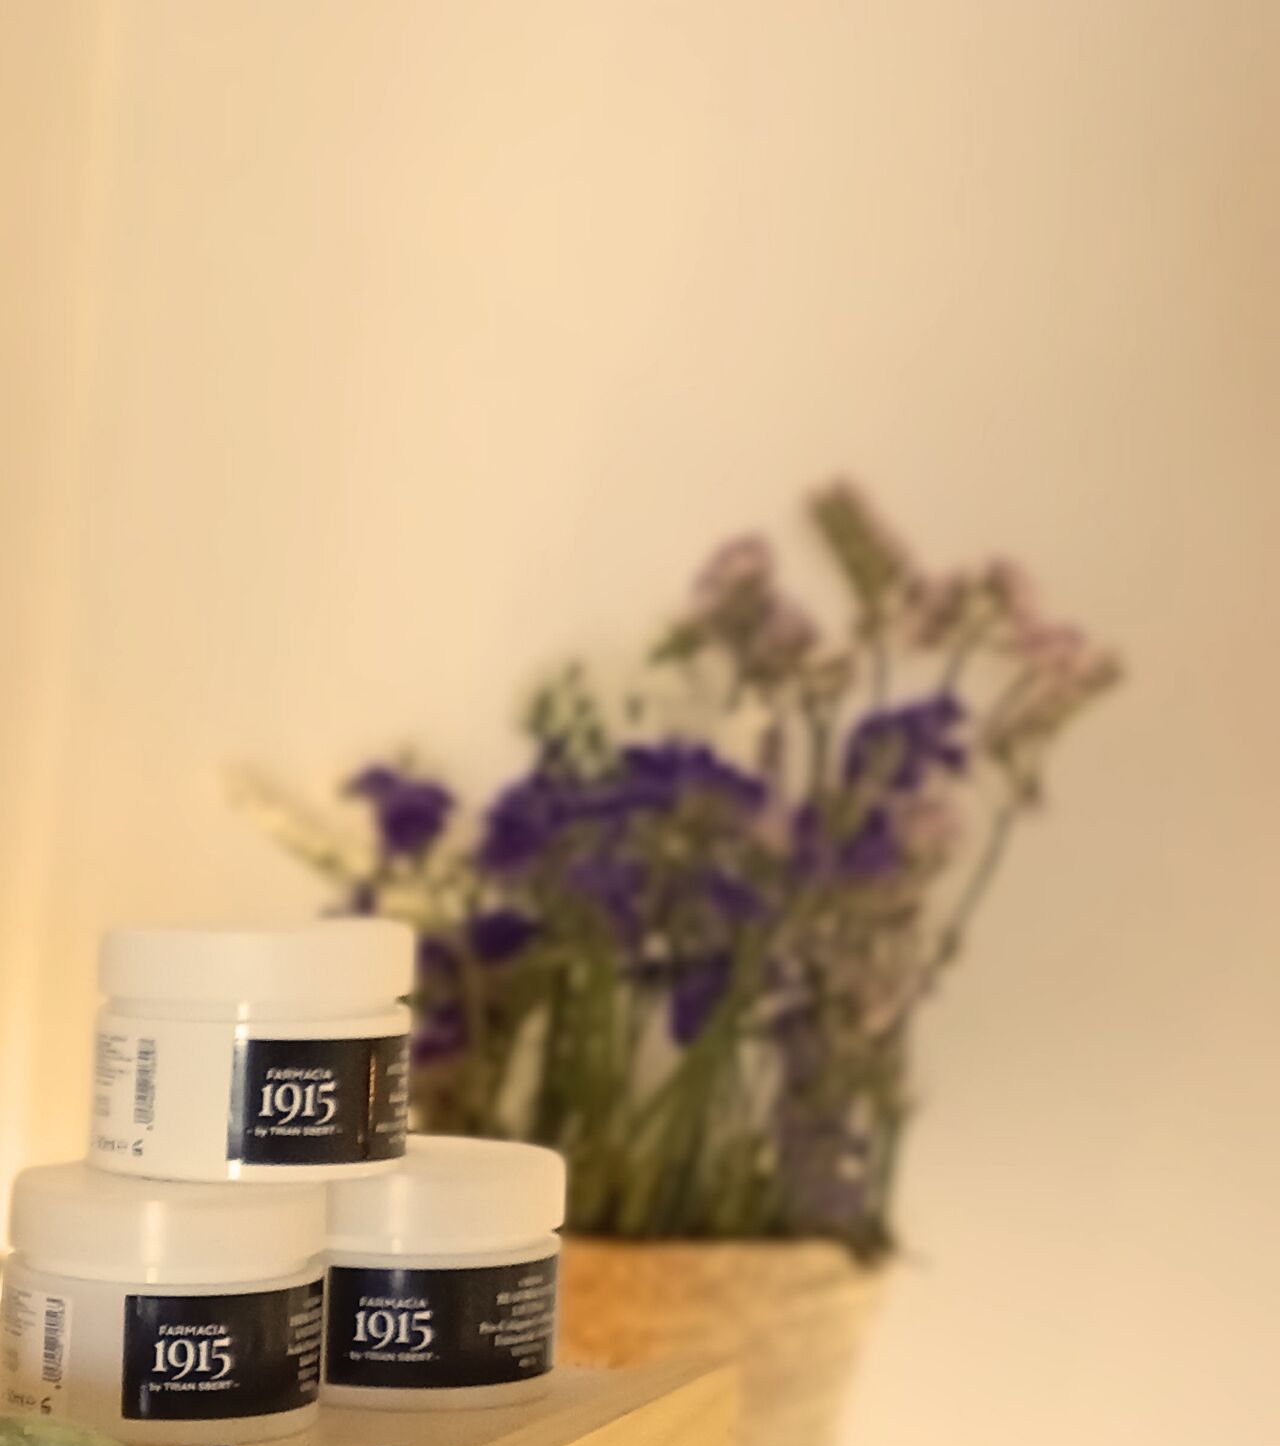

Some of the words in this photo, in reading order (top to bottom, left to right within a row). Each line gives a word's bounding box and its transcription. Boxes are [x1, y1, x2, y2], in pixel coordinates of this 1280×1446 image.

[258, 1080, 338, 1126] 1915
[158, 1324, 227, 1337] FARMACIA
[352, 1309, 434, 1352] 1915
[151, 1336, 234, 1381] 1915
